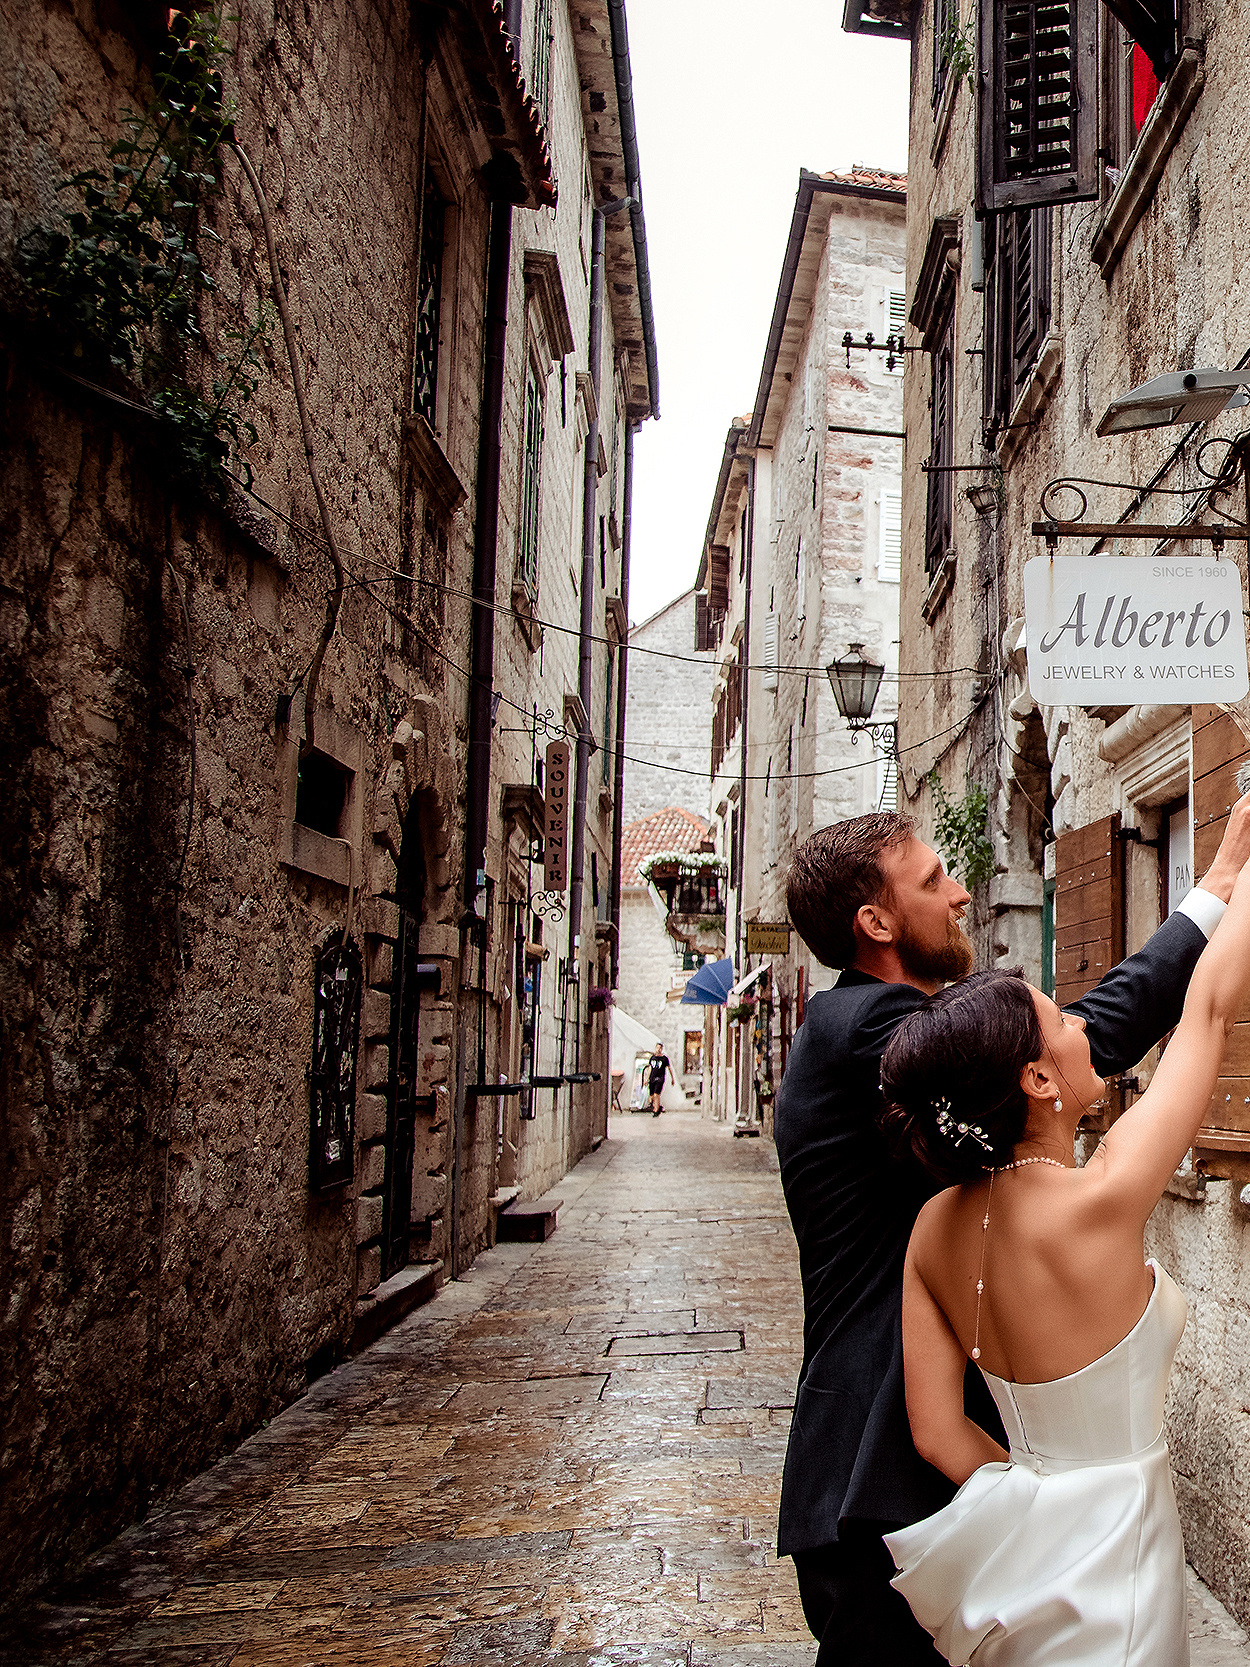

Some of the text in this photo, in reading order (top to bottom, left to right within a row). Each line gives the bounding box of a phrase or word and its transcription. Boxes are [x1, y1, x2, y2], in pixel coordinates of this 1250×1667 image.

[1152, 566, 1228, 578] SINCE 1960
[1039, 591, 1232, 654] Alberto
[1042, 664, 1236, 680] JEWELRY & WATCHES
[548, 753, 565, 881] SOUVENIR
